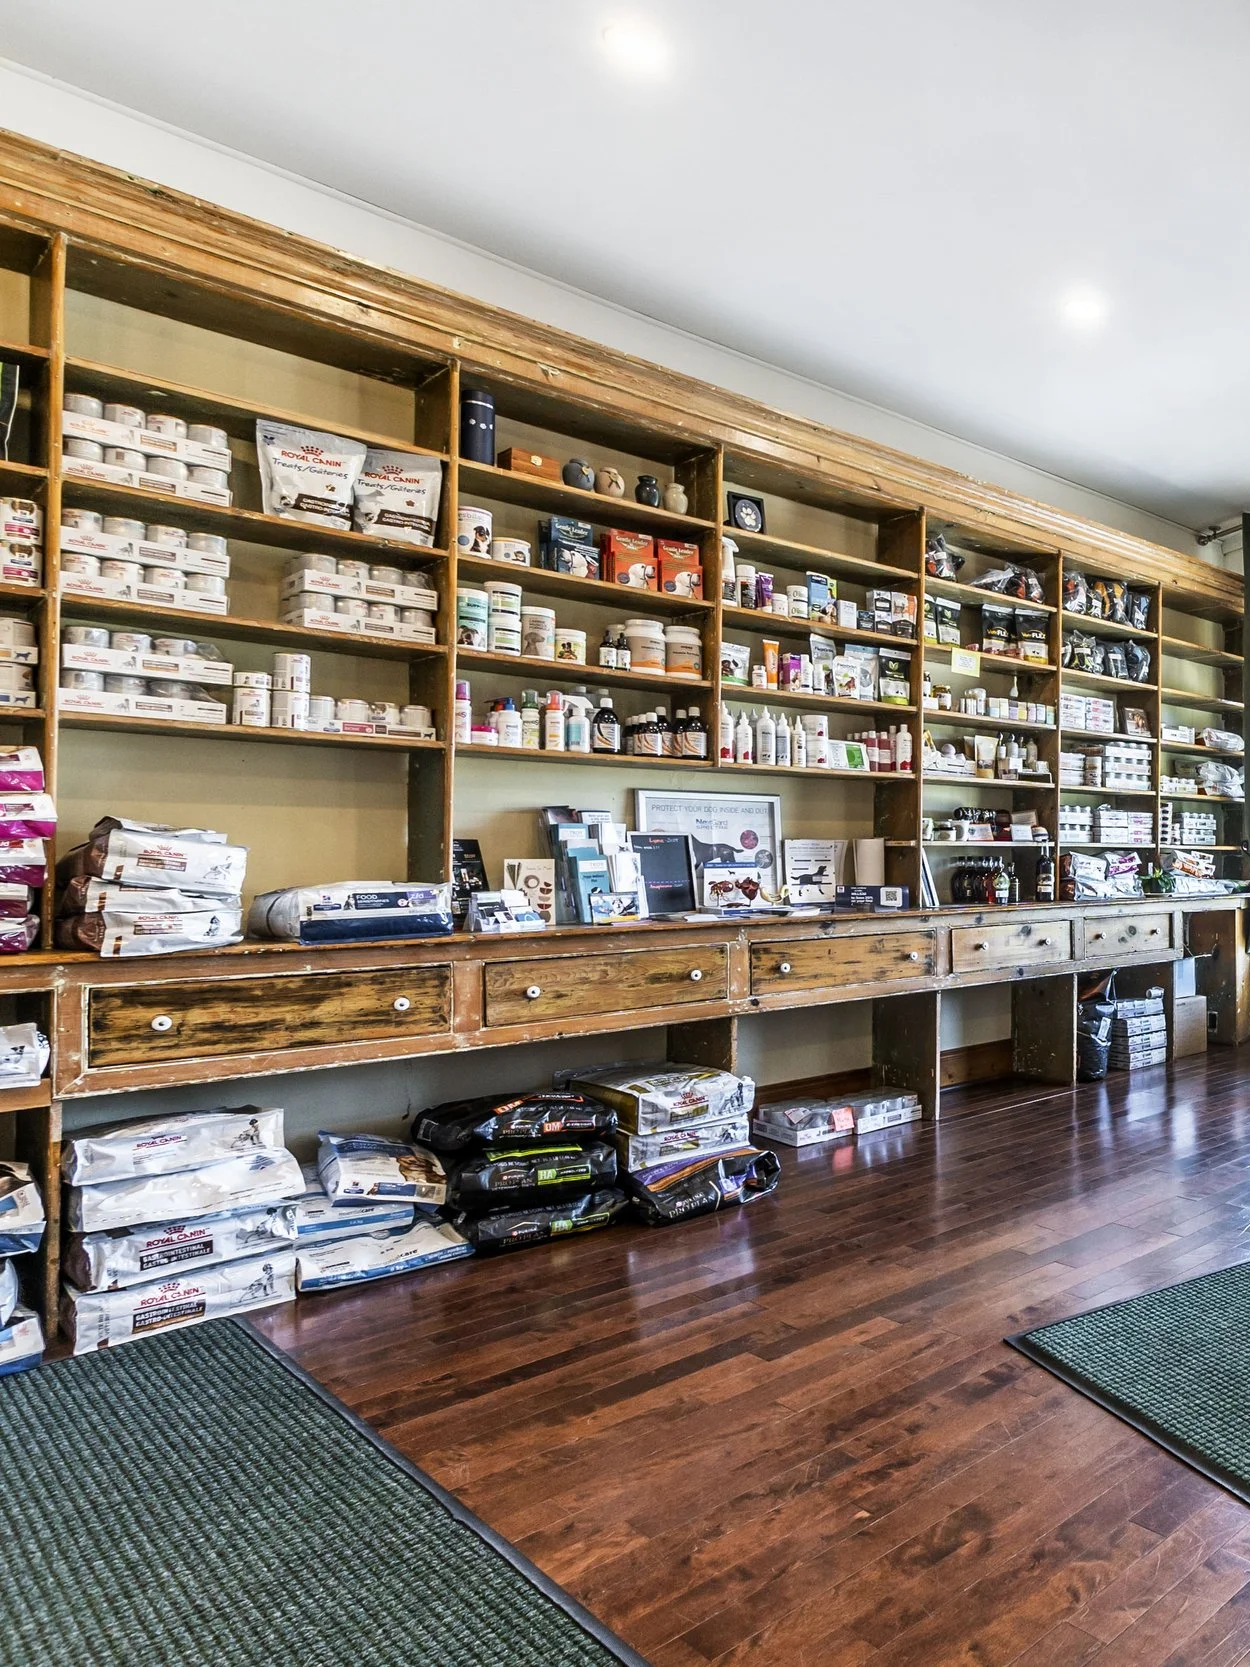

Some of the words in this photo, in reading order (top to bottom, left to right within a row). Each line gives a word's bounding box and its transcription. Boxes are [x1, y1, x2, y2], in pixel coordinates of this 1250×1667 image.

[281, 450, 310, 463] ROYAL
[312, 457, 342, 467] CANIN
[364, 471, 390, 482] ROYAL
[393, 475, 420, 485] CANIN
[556, 523, 570, 531] Gentle
[571, 526, 588, 535] Leader
[632, 538, 648, 546] Leader
[651, 804, 681, 813] PROTECT
[685, 805, 702, 813] YOUR
[720, 806, 738, 814] INSIDE
[696, 818, 728, 826] NexGard
[136, 1139, 158, 1149] ROYAL
[159, 1135, 182, 1144] CANIN
[690, 1194, 716, 1209] PLAN
[146, 1235, 176, 1248] ROYAL
[177, 1229, 206, 1241] CANIN
[142, 1243, 205, 1263] GASTROINTESTINAL
[140, 1294, 170, 1307] ROYAL
[171, 1287, 200, 1299] CANIN
